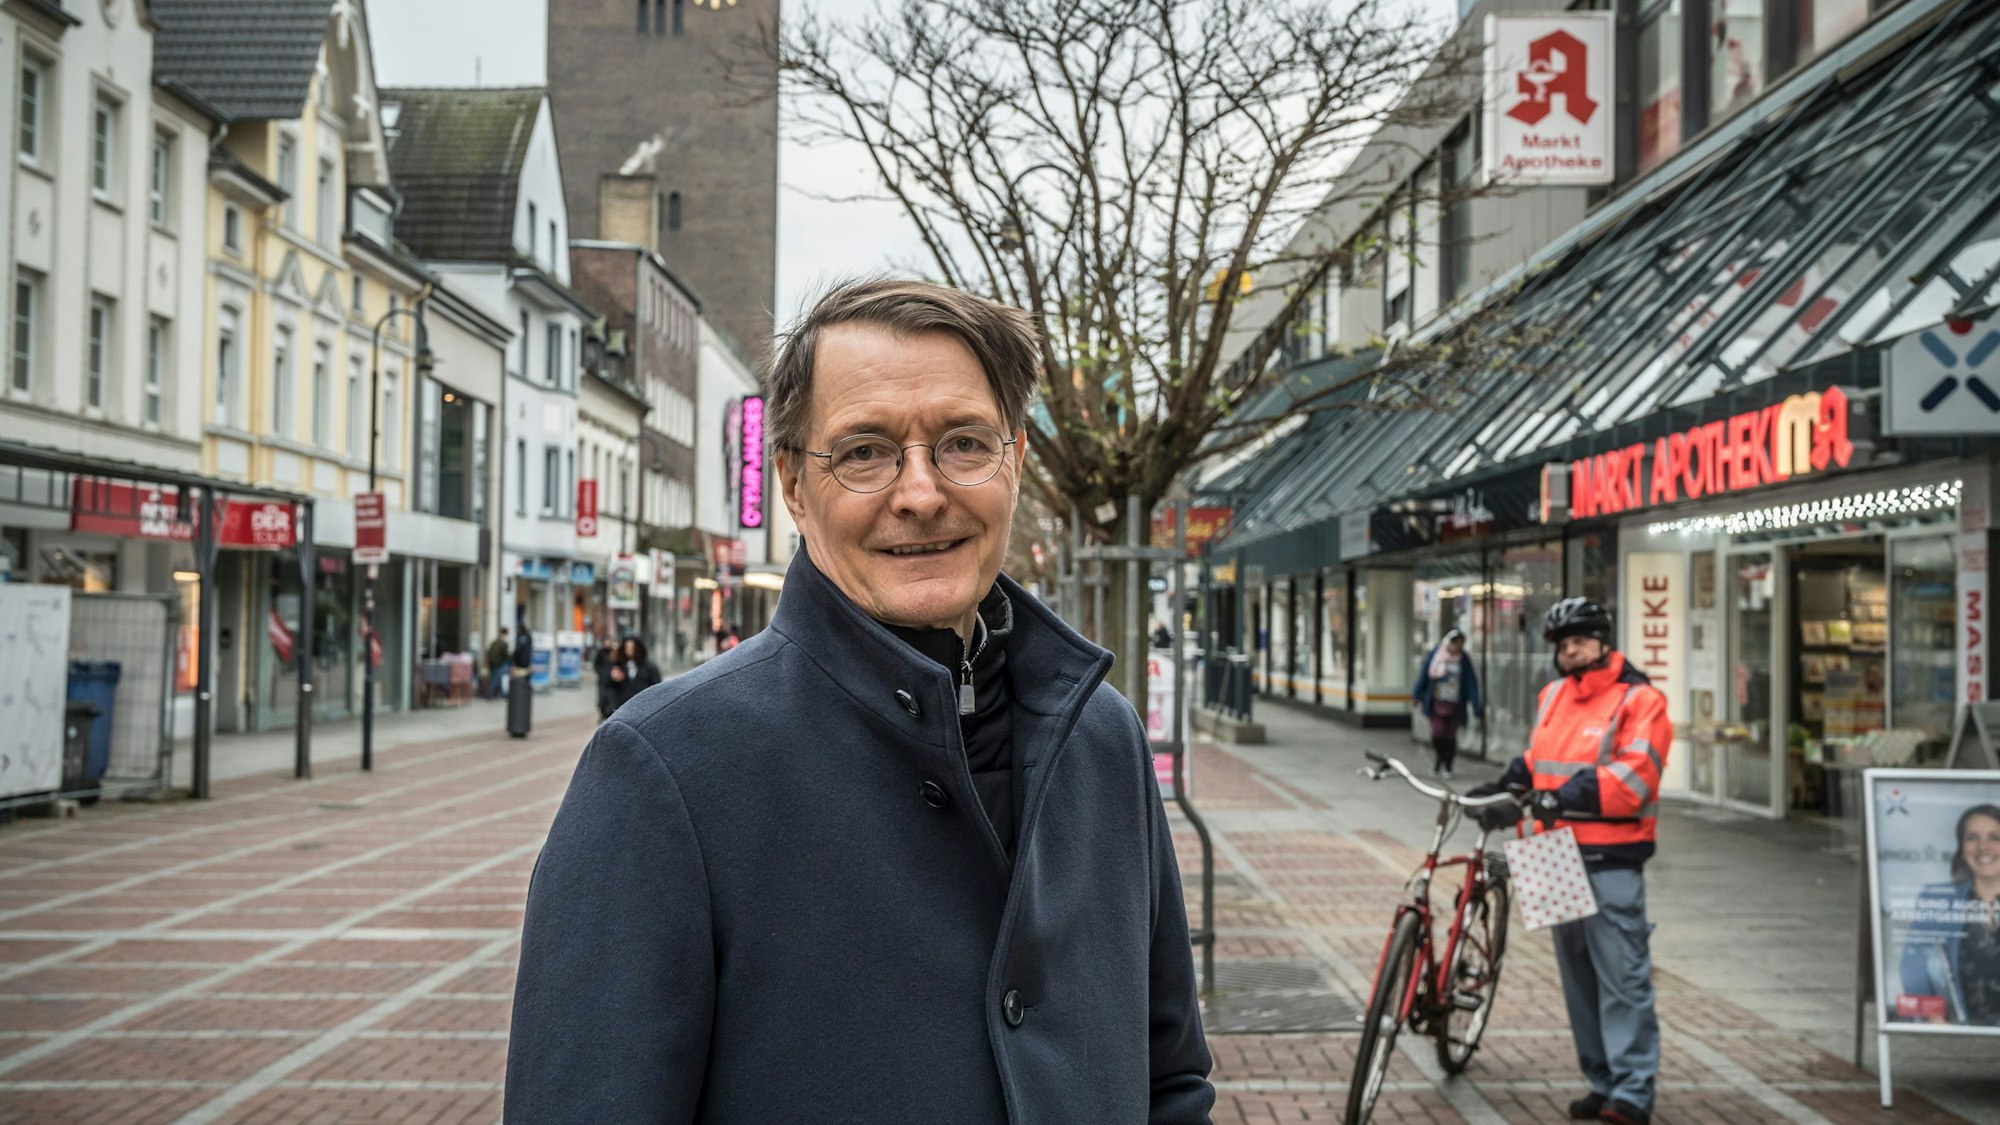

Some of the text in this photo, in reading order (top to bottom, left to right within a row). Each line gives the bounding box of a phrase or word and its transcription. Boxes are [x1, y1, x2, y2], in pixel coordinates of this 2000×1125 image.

[1522, 134, 1580, 148] Markt
[1503, 153, 1602, 170] Apotheke
[1571, 442, 1646, 519] MARKT
